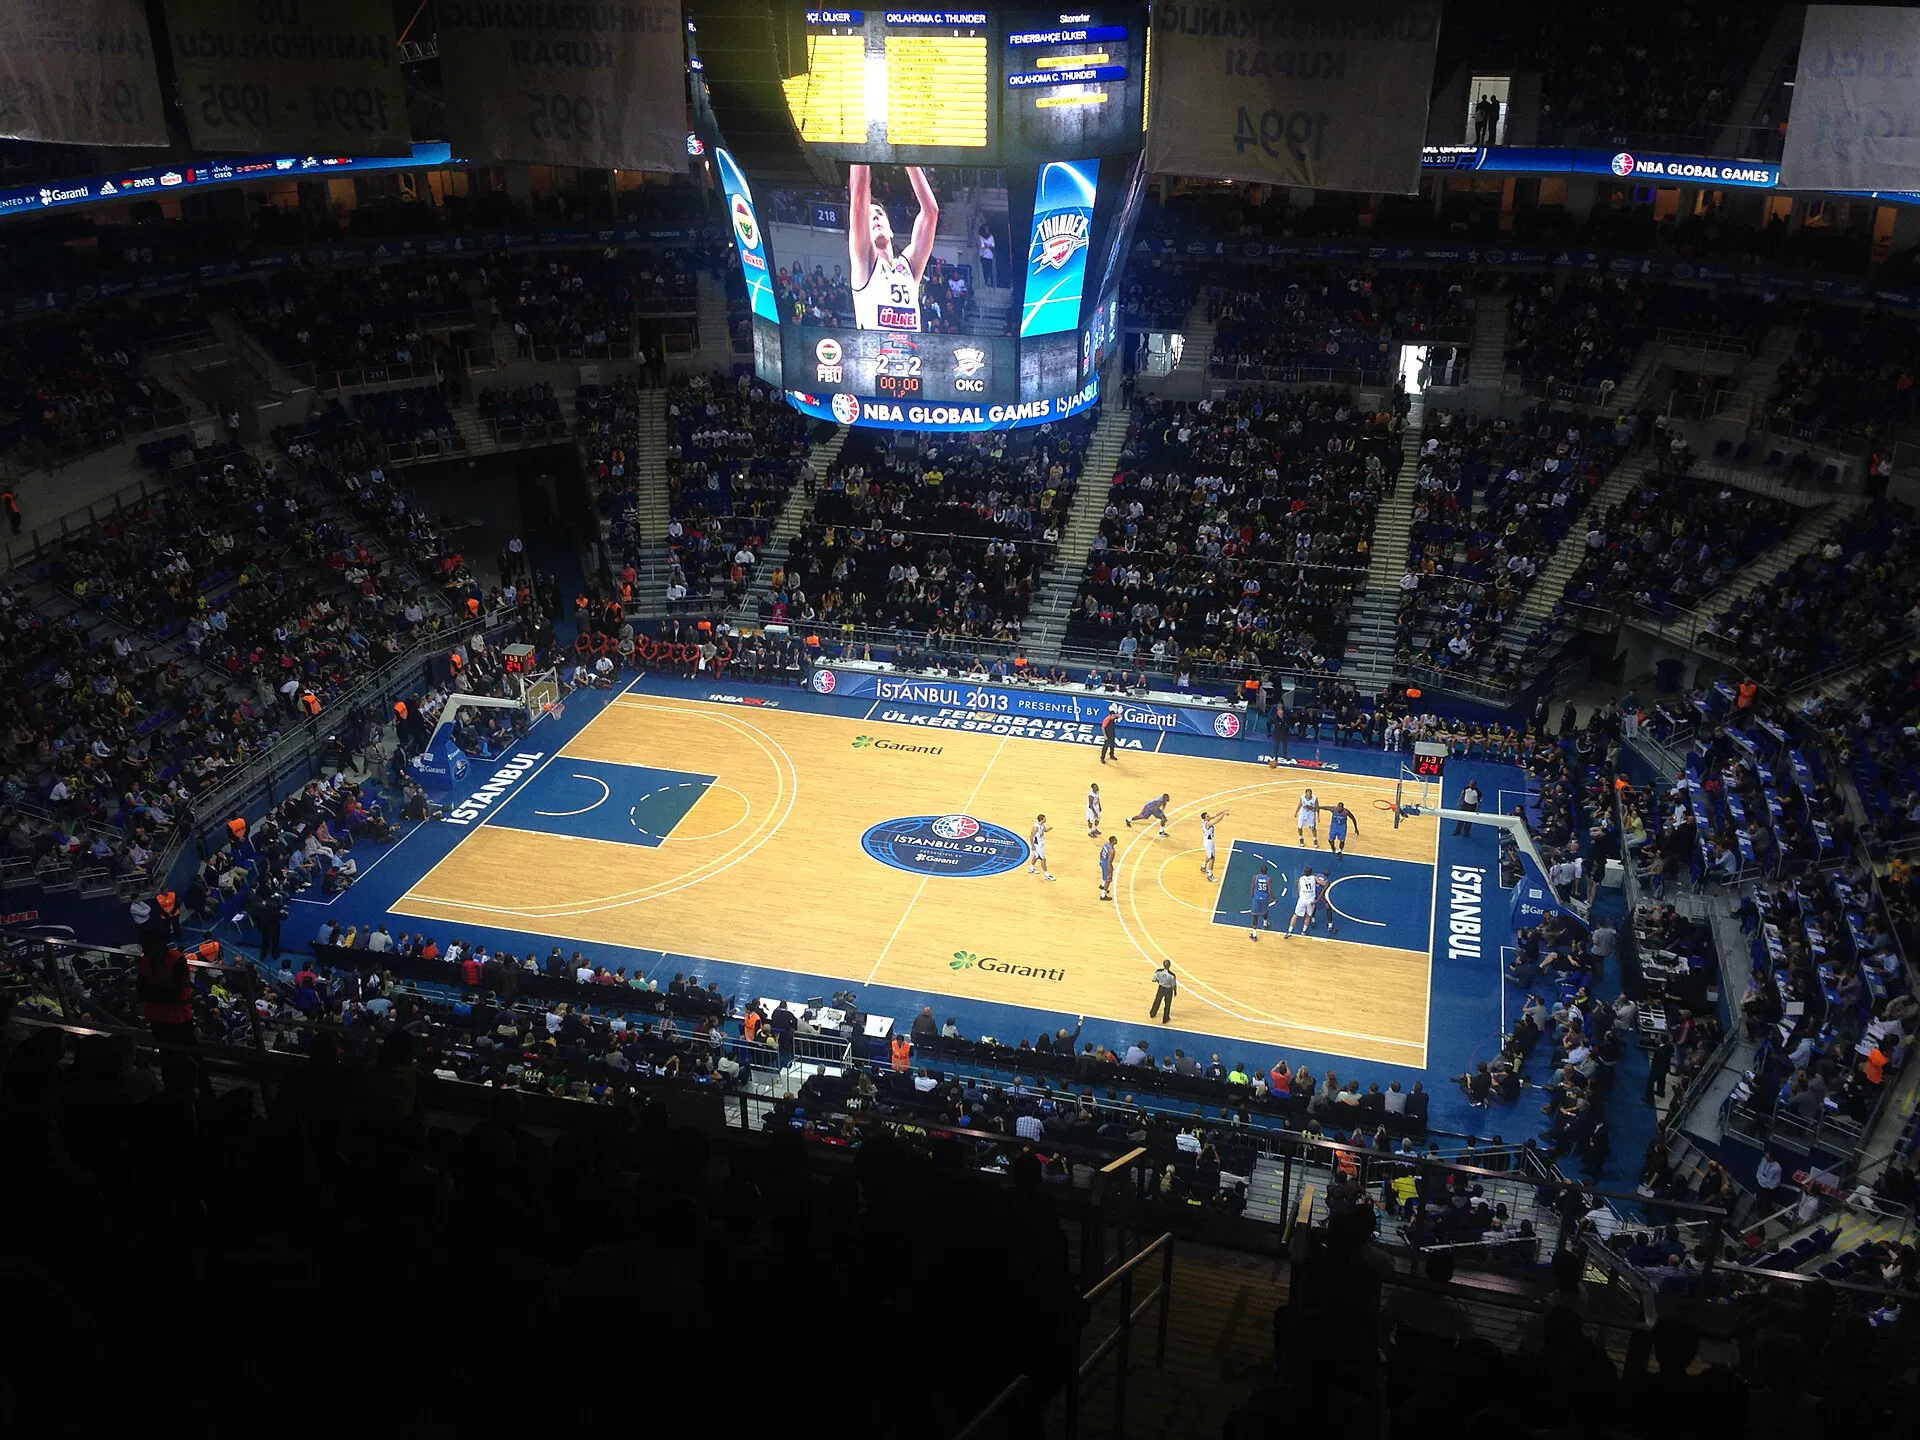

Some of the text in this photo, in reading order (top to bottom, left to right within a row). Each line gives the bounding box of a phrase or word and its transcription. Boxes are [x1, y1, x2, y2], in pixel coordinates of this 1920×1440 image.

[886, 14, 932, 23] OKLAHOMA
[945, 14, 986, 24] THUNDER
[1010, 30, 1086, 44] FENERBAHÇE ÜLKER
[1010, 75, 1052, 84] OKLAHOMA
[1061, 70, 1096, 80] THUNDER
[1636, 161, 1664, 174] NBA
[1668, 163, 1718, 179] GLOBAL
[1722, 168, 1769, 183] GAMES
[134, 176, 155, 188] avea
[26, 196, 35, 204] BY
[51, 186, 89, 201] Garanti
[818, 210, 836, 221] 218
[1037, 214, 1089, 241] THUNDER
[891, 284, 910, 304] 55
[877, 354, 889, 374] 2
[908, 356, 921, 376] 2
[818, 371, 842, 383] FBU
[880, 377, 919, 391] 00:00
[955, 379, 984, 392] OKC
[864, 403, 903, 421] NBA
[908, 404, 984, 424] GLOBAL
[988, 400, 1049, 422] GAMES
[506, 661, 521, 671] 24
[876, 679, 1176, 727] İSTANBUL 2013 PRESENTED BY Garanti
[882, 709, 958, 729] ÜLKER
[961, 721, 1056, 739] SPORTS
[874, 739, 943, 755] Garanti
[1419, 763, 1438, 775] 24
[441, 751, 544, 825] İSTANBUL
[894, 834, 997, 855] İSTANBUL 2013
[926, 855, 959, 865] Garanti
[1258, 883, 1267, 891] 35
[1448, 864, 1487, 960] İSTANBUL
[977, 957, 1066, 981] Garanti
